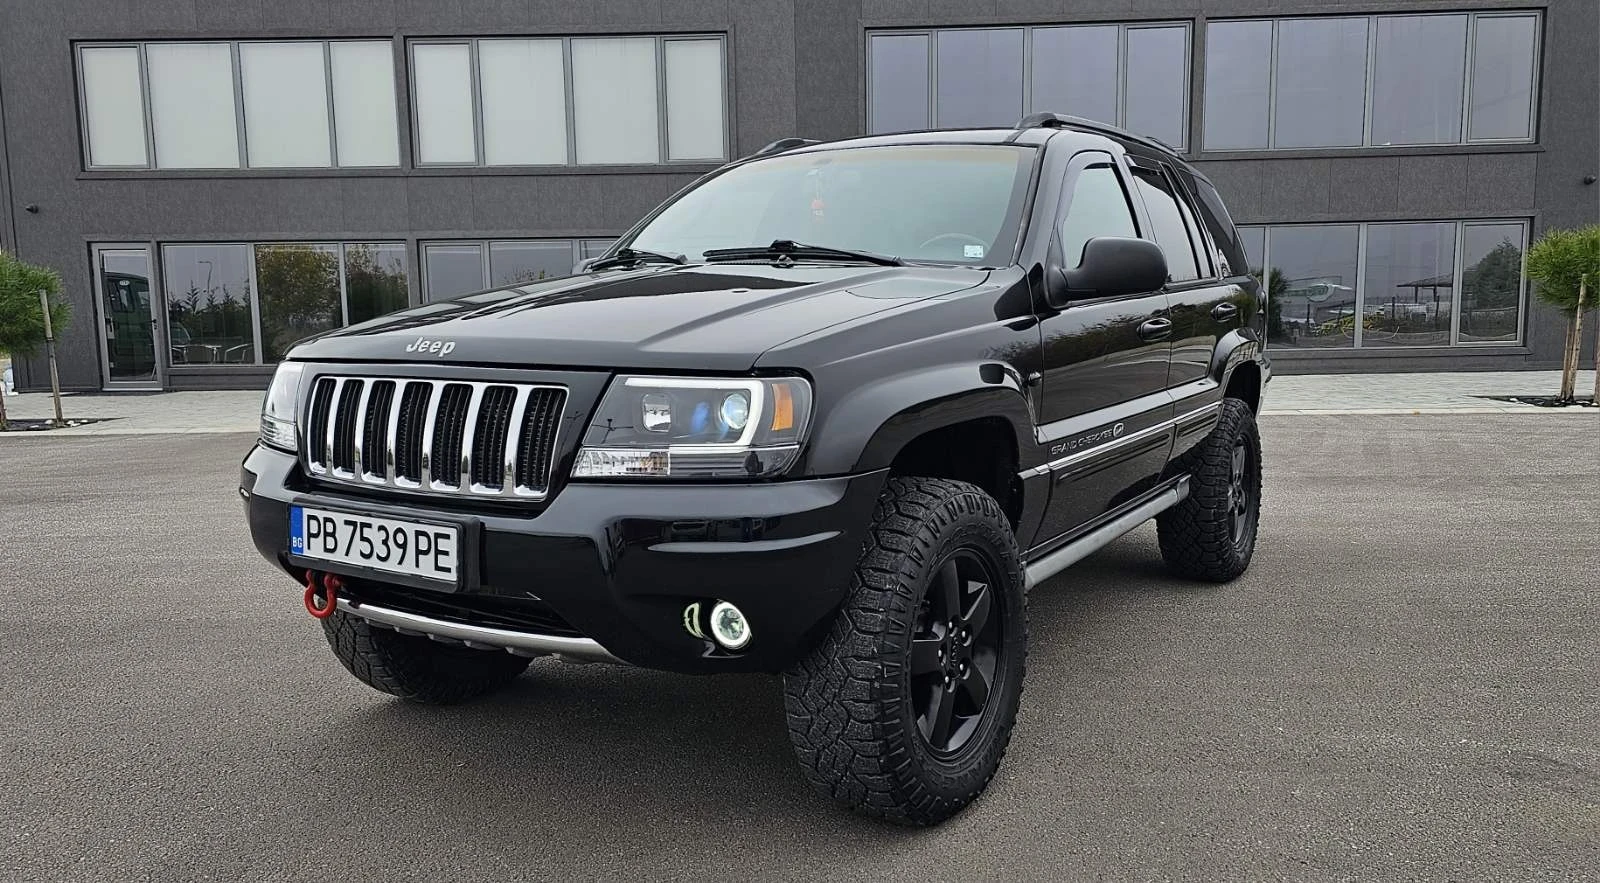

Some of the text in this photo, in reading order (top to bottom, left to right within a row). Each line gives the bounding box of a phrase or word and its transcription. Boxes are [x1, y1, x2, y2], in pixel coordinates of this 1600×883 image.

[406, 337, 456, 357] Jeep
[1051, 442, 1077, 455] GRAND
[292, 537, 303, 548] BG
[306, 514, 452, 573] PB 7539 PE
